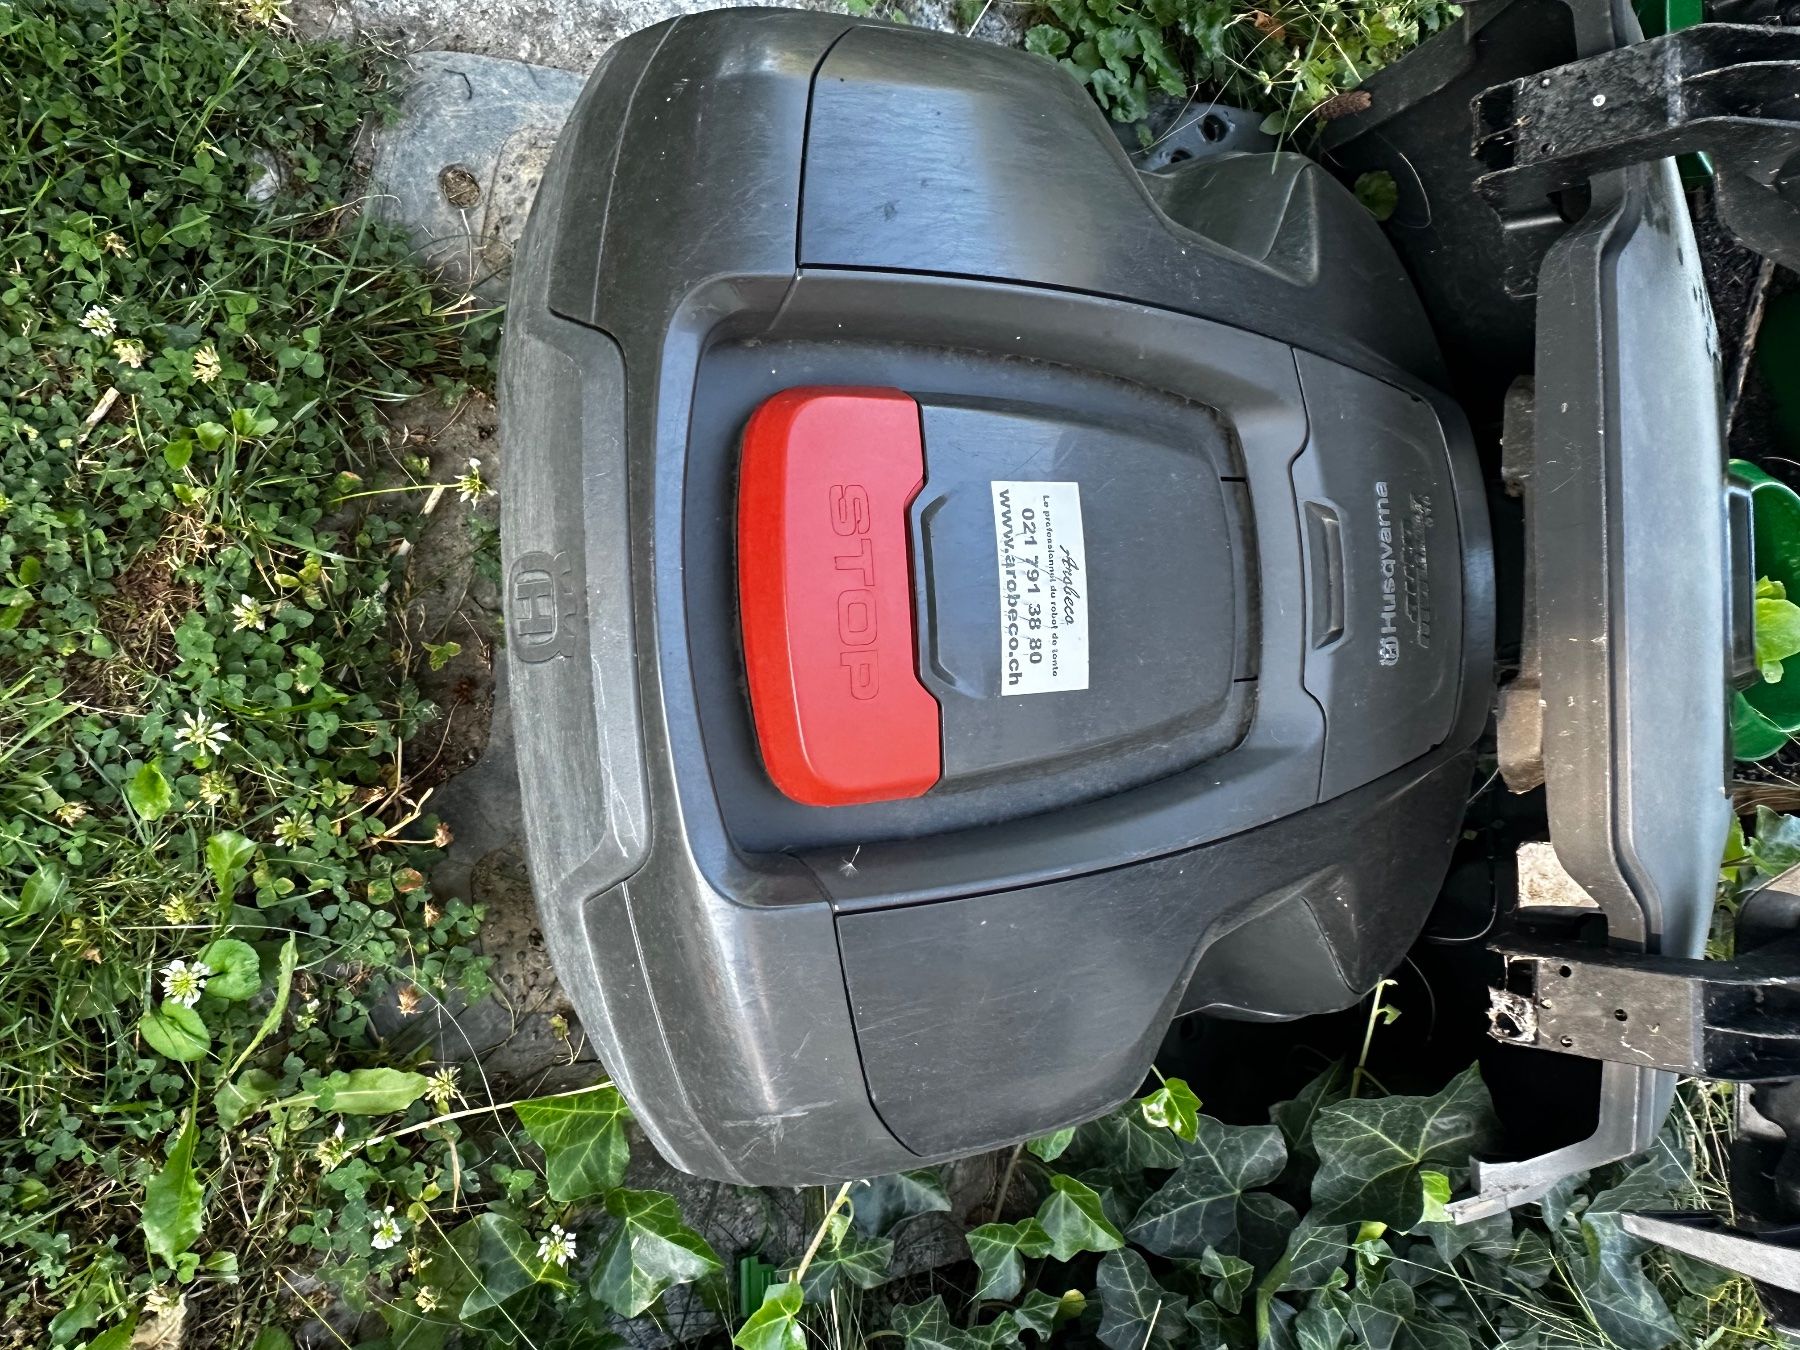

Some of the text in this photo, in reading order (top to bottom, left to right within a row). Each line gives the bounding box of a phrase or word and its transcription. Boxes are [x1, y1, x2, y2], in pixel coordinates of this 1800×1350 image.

[829, 484, 880, 700] STOP
[999, 489, 1023, 686] www.arobeco.ch
[1021, 508, 1042, 664] 021 791 38 80
[1050, 586, 1057, 599] du
[1050, 602, 1058, 629] robot
[1059, 544, 1080, 626] Arobeco
[1375, 481, 1397, 634] Husqvarna
[1051, 632, 1058, 646] de
